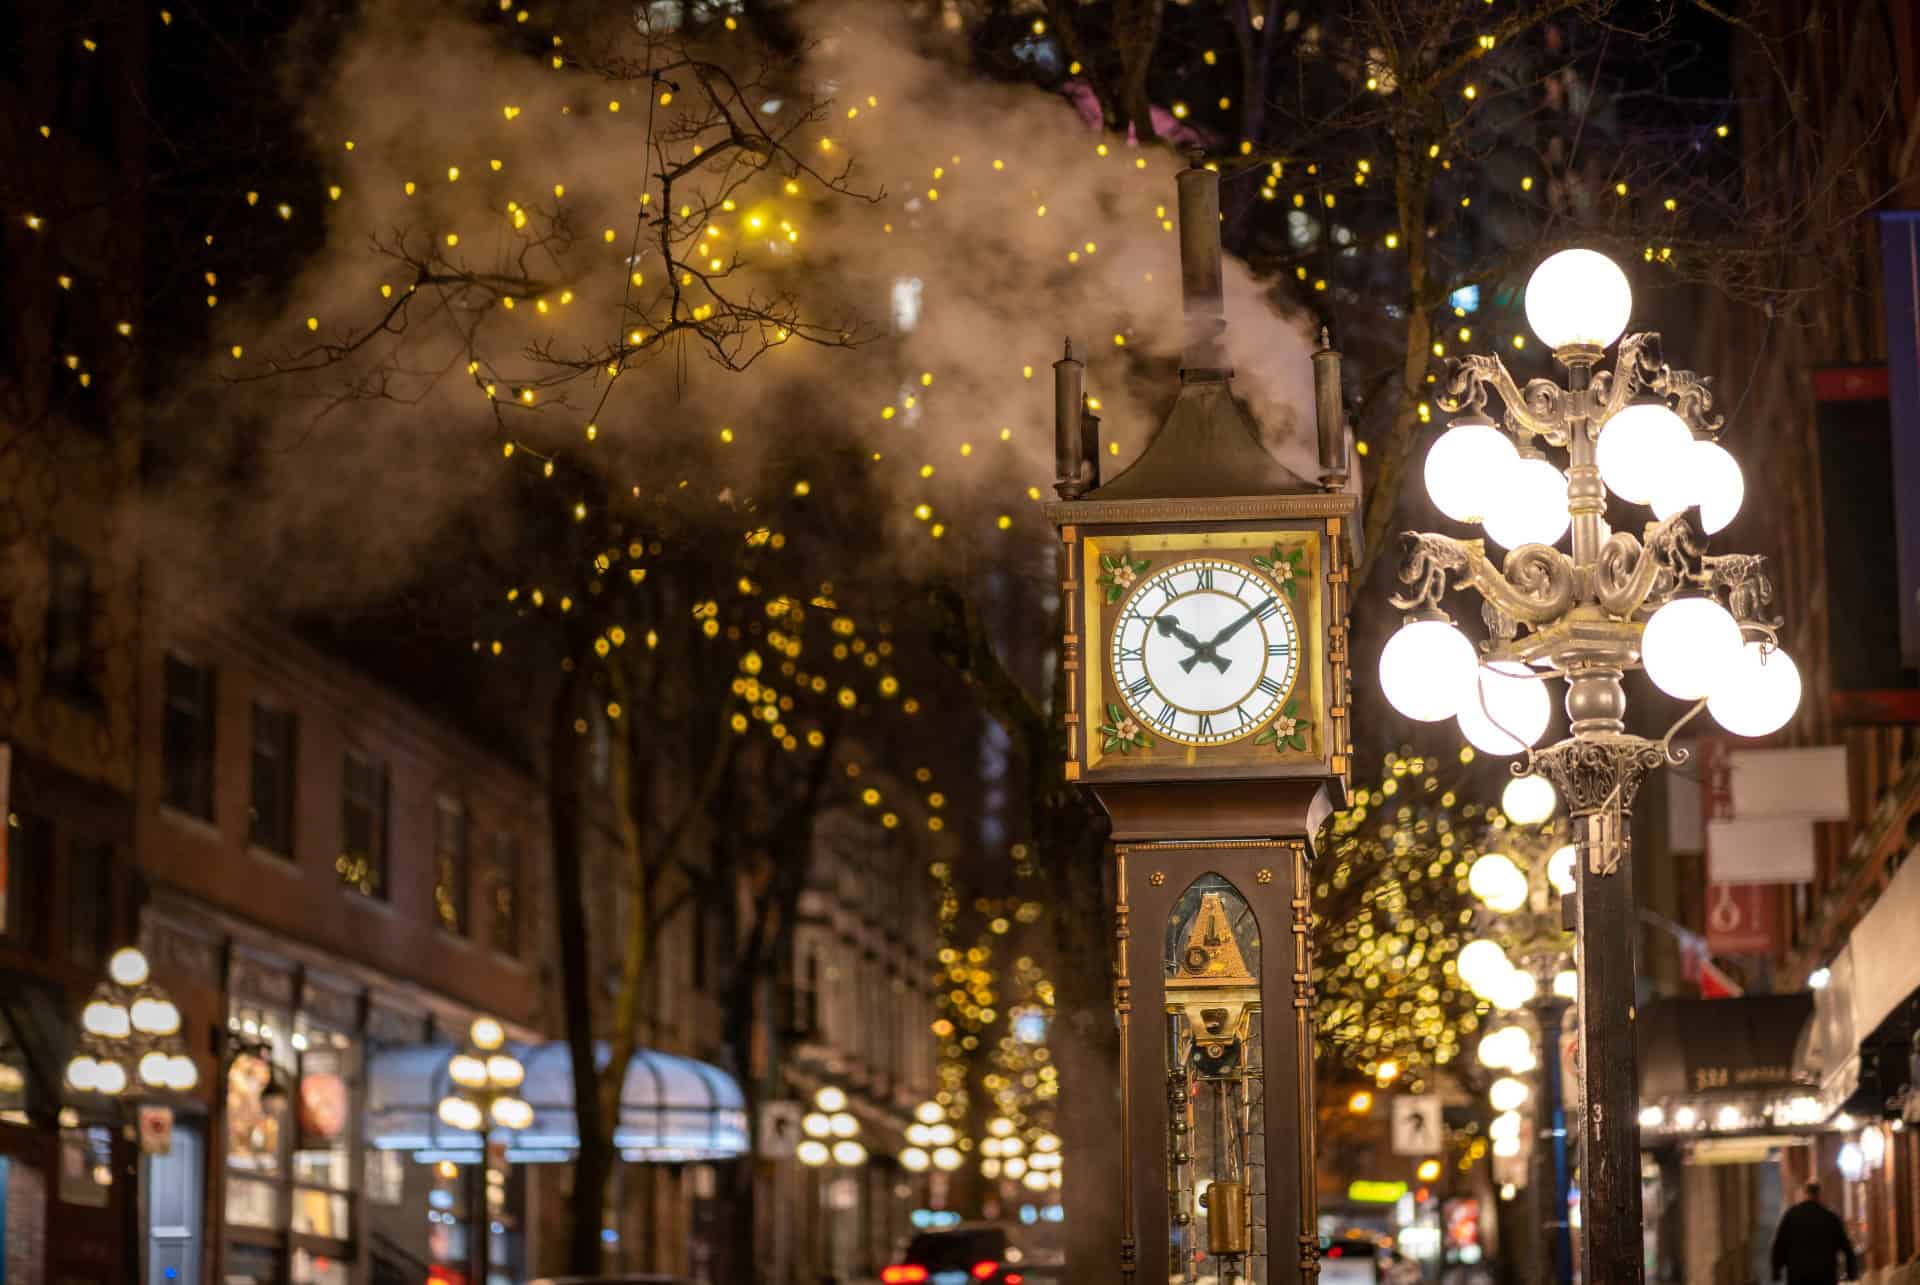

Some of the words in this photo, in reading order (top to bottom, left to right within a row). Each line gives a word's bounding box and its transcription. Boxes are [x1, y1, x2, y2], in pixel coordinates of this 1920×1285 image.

[1158, 578, 1179, 602] XI
[1196, 569, 1214, 591] XII
[1120, 647, 1142, 661] IX
[1267, 643, 1289, 656] III
[1198, 713, 1214, 735] VI
[1237, 704, 1254, 726] V
